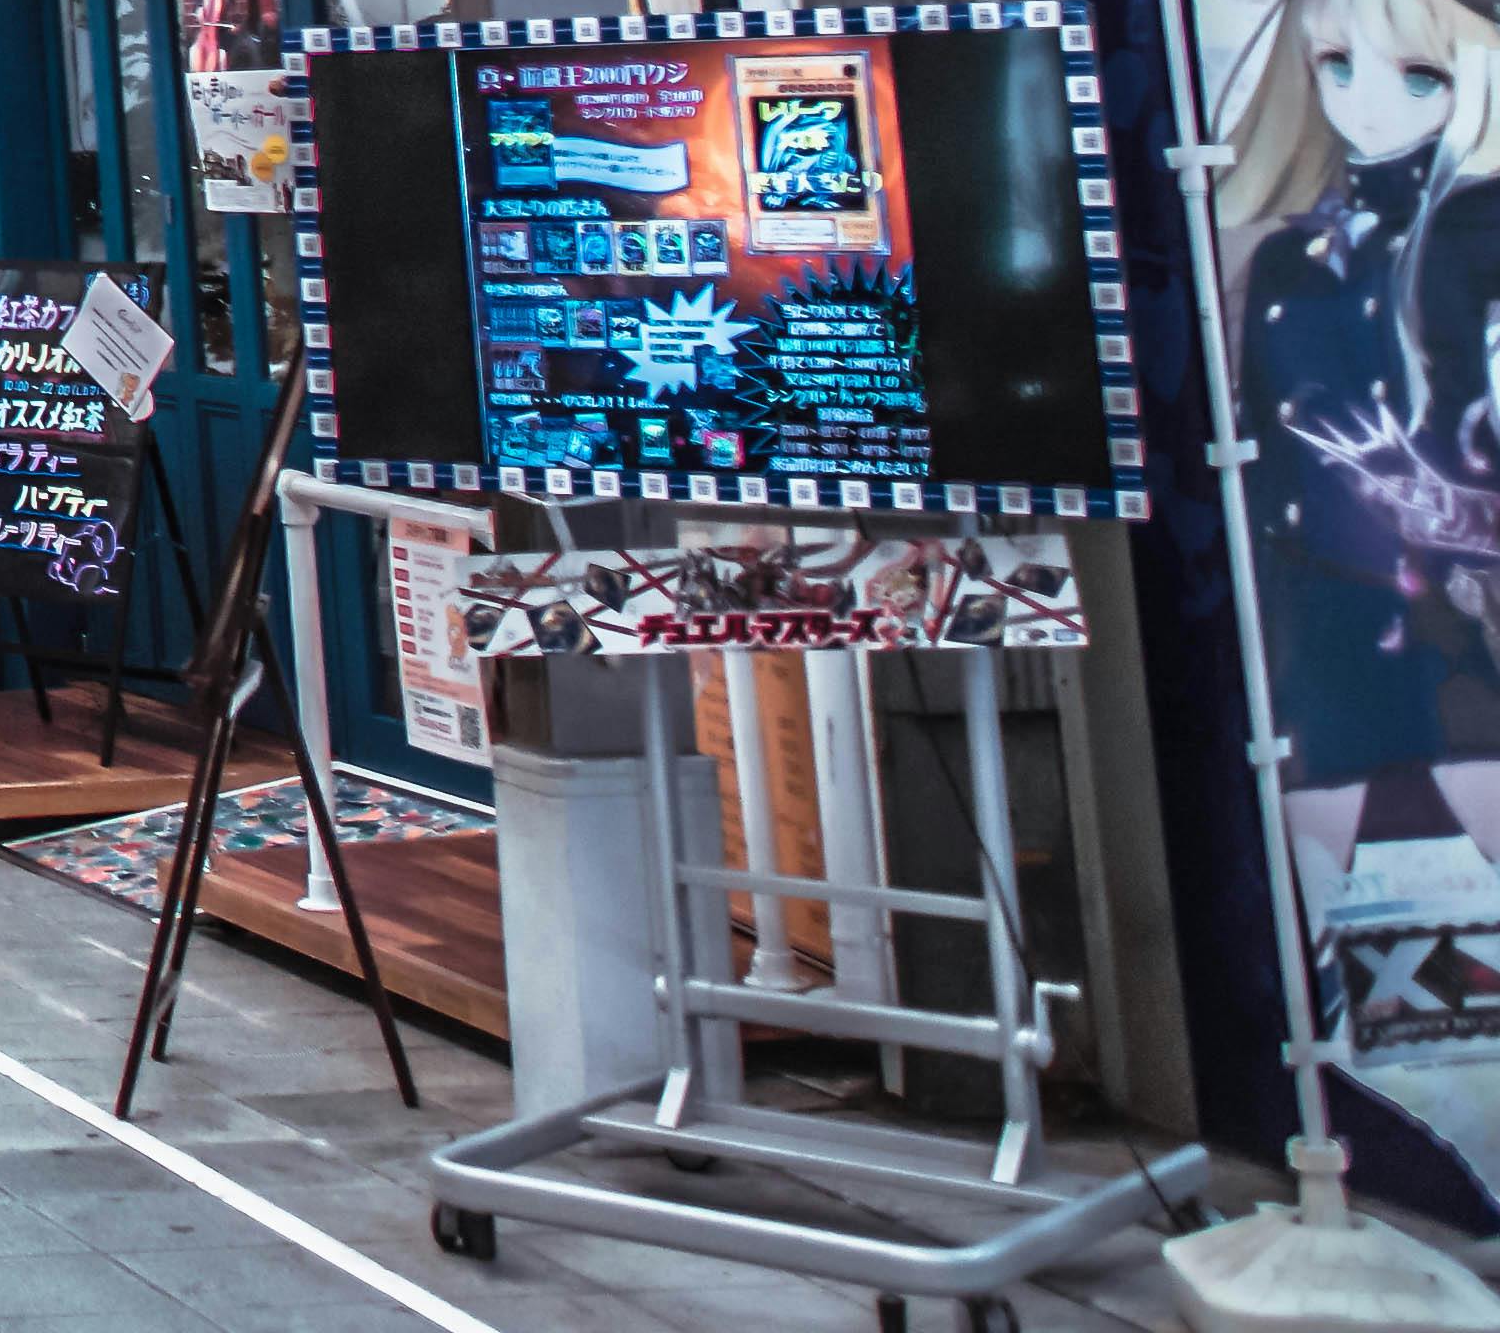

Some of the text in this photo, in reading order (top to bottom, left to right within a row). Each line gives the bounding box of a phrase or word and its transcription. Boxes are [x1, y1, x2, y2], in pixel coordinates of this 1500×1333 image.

[636, 608, 886, 647] デュエルマスターズ
